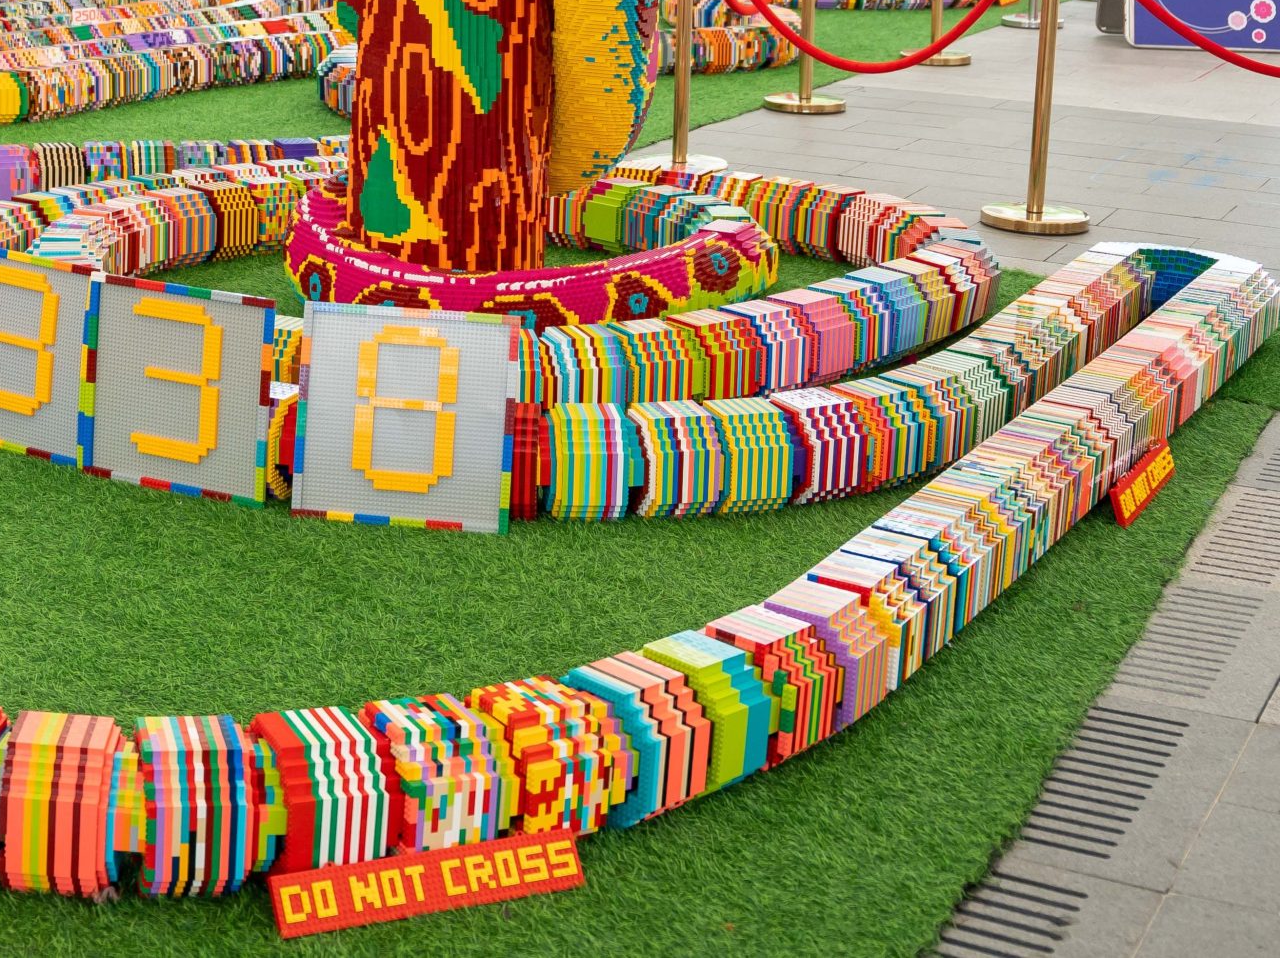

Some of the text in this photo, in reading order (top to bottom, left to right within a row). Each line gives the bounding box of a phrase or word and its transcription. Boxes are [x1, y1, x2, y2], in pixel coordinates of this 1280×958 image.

[74, 9, 96, 22] 250
[279, 839, 578, 924] DO NOT CROSS
